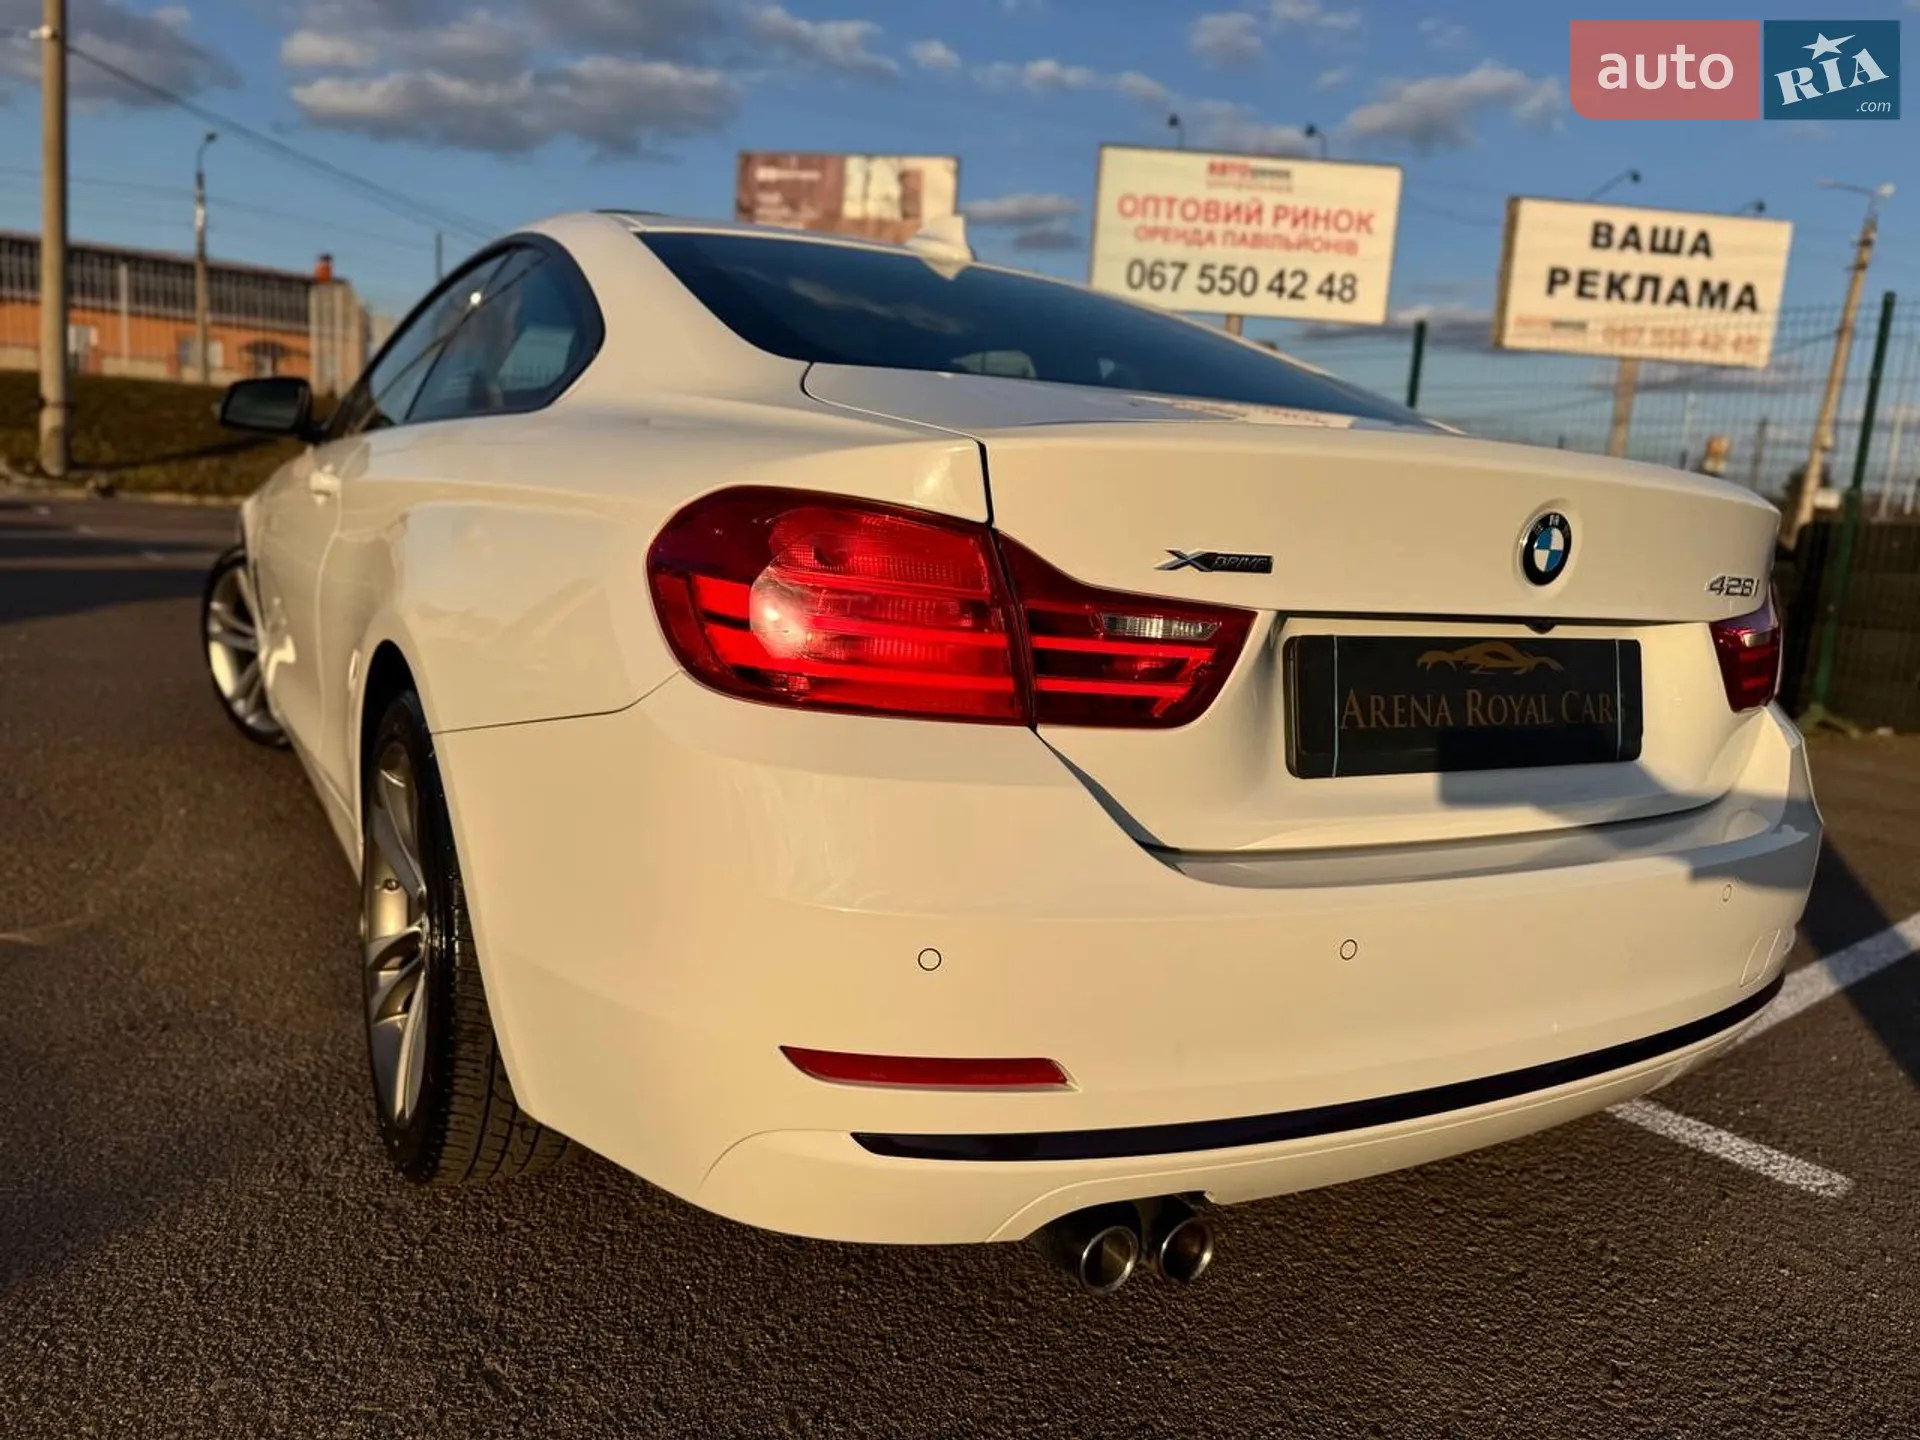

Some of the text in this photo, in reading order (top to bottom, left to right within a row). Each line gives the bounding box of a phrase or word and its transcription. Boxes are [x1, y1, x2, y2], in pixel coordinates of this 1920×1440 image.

[1117, 193, 1376, 235] ОПТОВИЙ РИНОК
[1134, 225, 1214, 248] ОРЕНДА
[1590, 220, 1713, 259] ВАША
[1126, 258, 1358, 304] 067 550 42 48
[1546, 266, 1759, 313] РЕКЛАМА
[1340, 687, 1454, 730] ARENA
[1466, 688, 1553, 727] ROYAL
